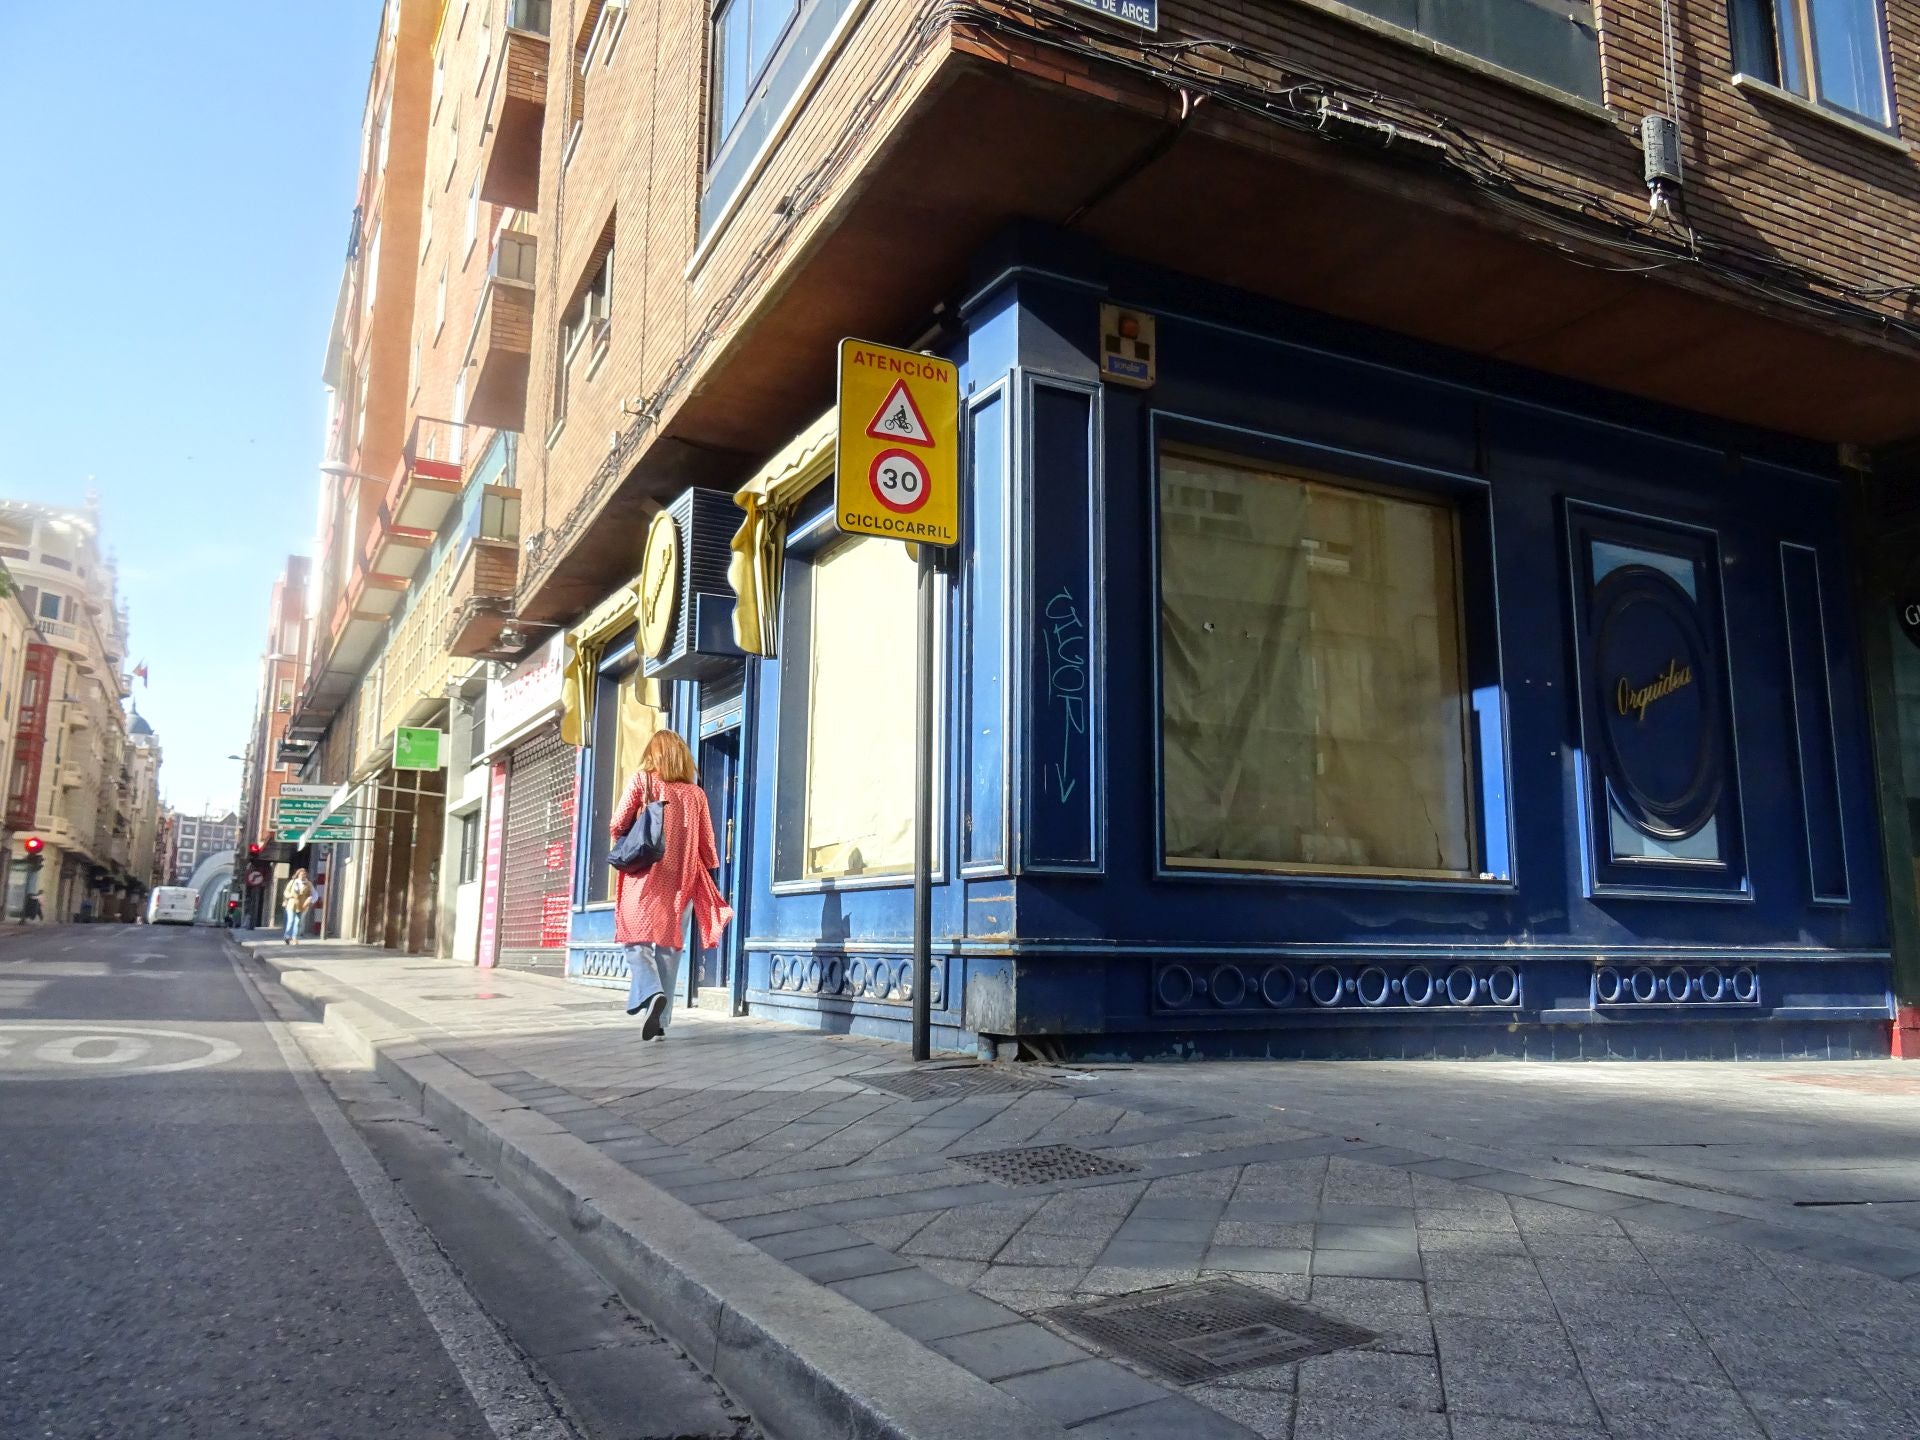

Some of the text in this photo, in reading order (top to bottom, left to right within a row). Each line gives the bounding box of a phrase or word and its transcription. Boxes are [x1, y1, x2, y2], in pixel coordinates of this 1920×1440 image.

[1121, 1, 1149, 24] ARCE
[853, 350, 948, 383] ATENCIÓN
[882, 468, 918, 492] 30
[845, 512, 951, 539] CICLOCARRIL
